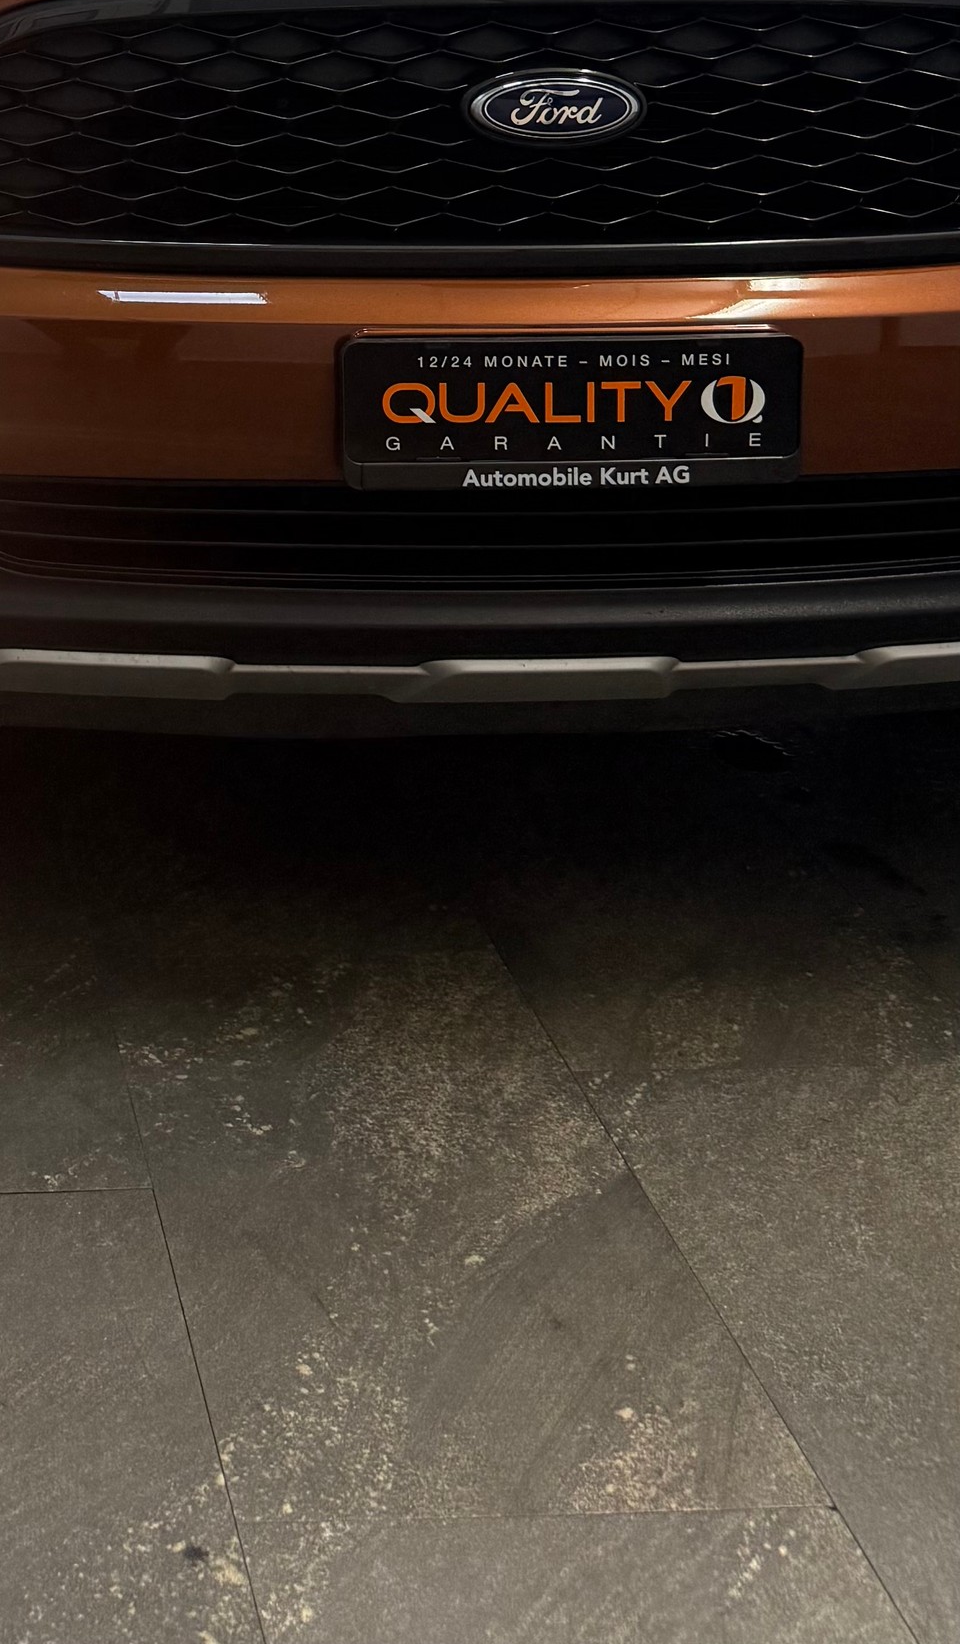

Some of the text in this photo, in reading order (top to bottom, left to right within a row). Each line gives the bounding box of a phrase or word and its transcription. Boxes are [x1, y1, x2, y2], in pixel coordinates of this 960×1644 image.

[510, 88, 604, 126] Ford
[416, 355, 473, 368] 12/24
[483, 355, 569, 368] MONATE
[599, 354, 651, 368] MOIS
[681, 353, 731, 366] MESI
[382, 380, 692, 424] QUALITY
[385, 432, 762, 452] GARANTIE
[461, 465, 691, 488] Automobile Kurt AG
